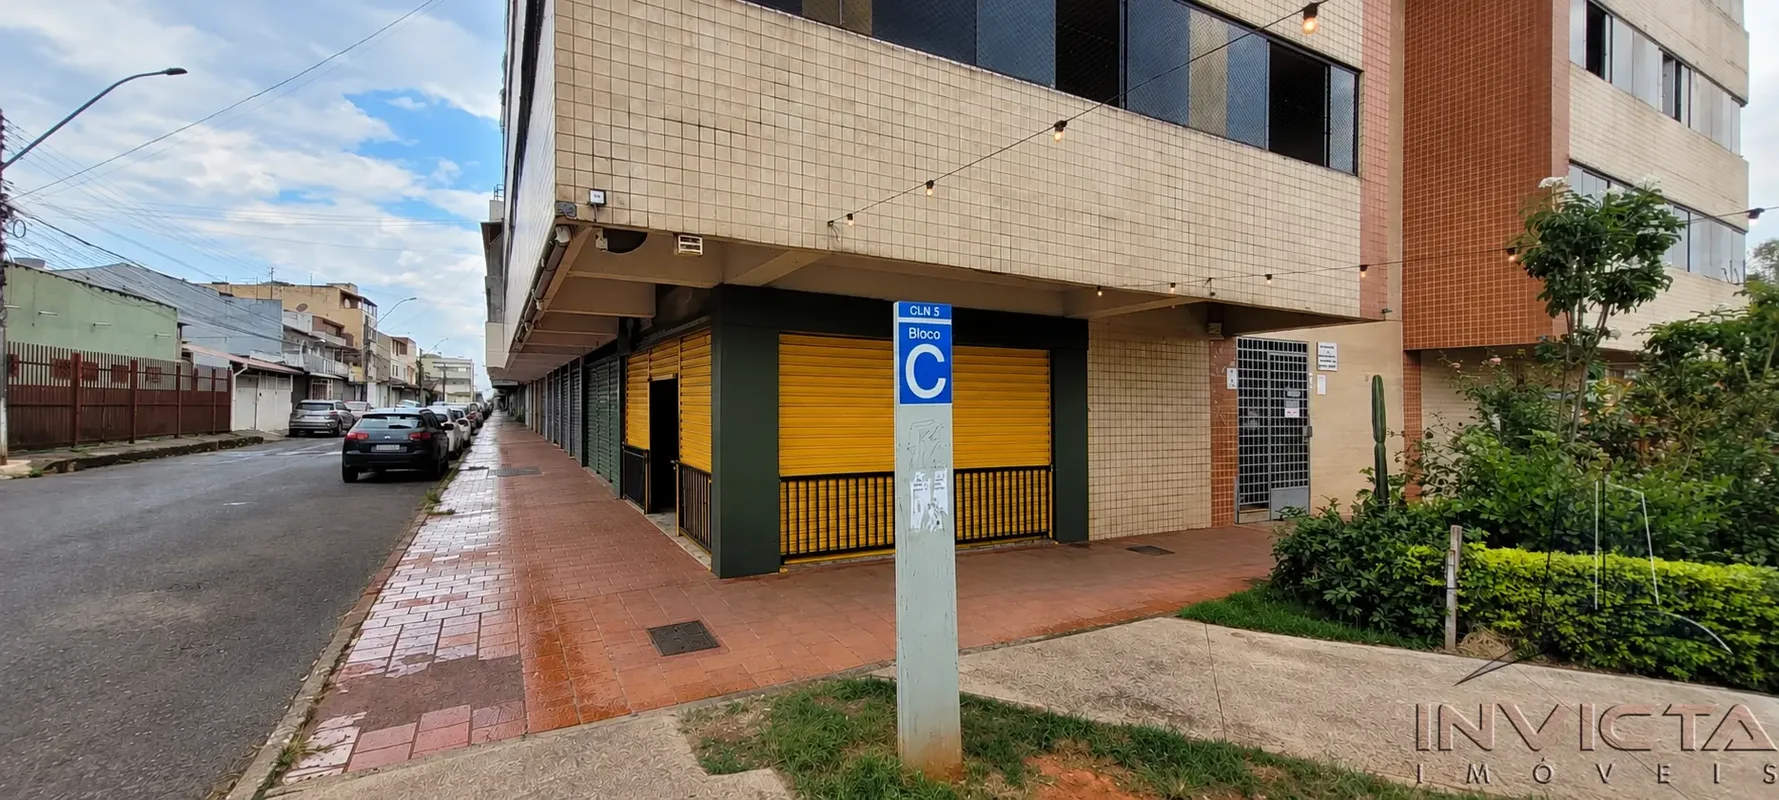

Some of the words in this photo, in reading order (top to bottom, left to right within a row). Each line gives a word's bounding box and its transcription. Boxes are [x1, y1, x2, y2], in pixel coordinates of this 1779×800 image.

[909, 305, 931, 316] CLN
[933, 306, 940, 317] 5
[908, 327, 941, 340] Bloco
[905, 343, 946, 399] C
